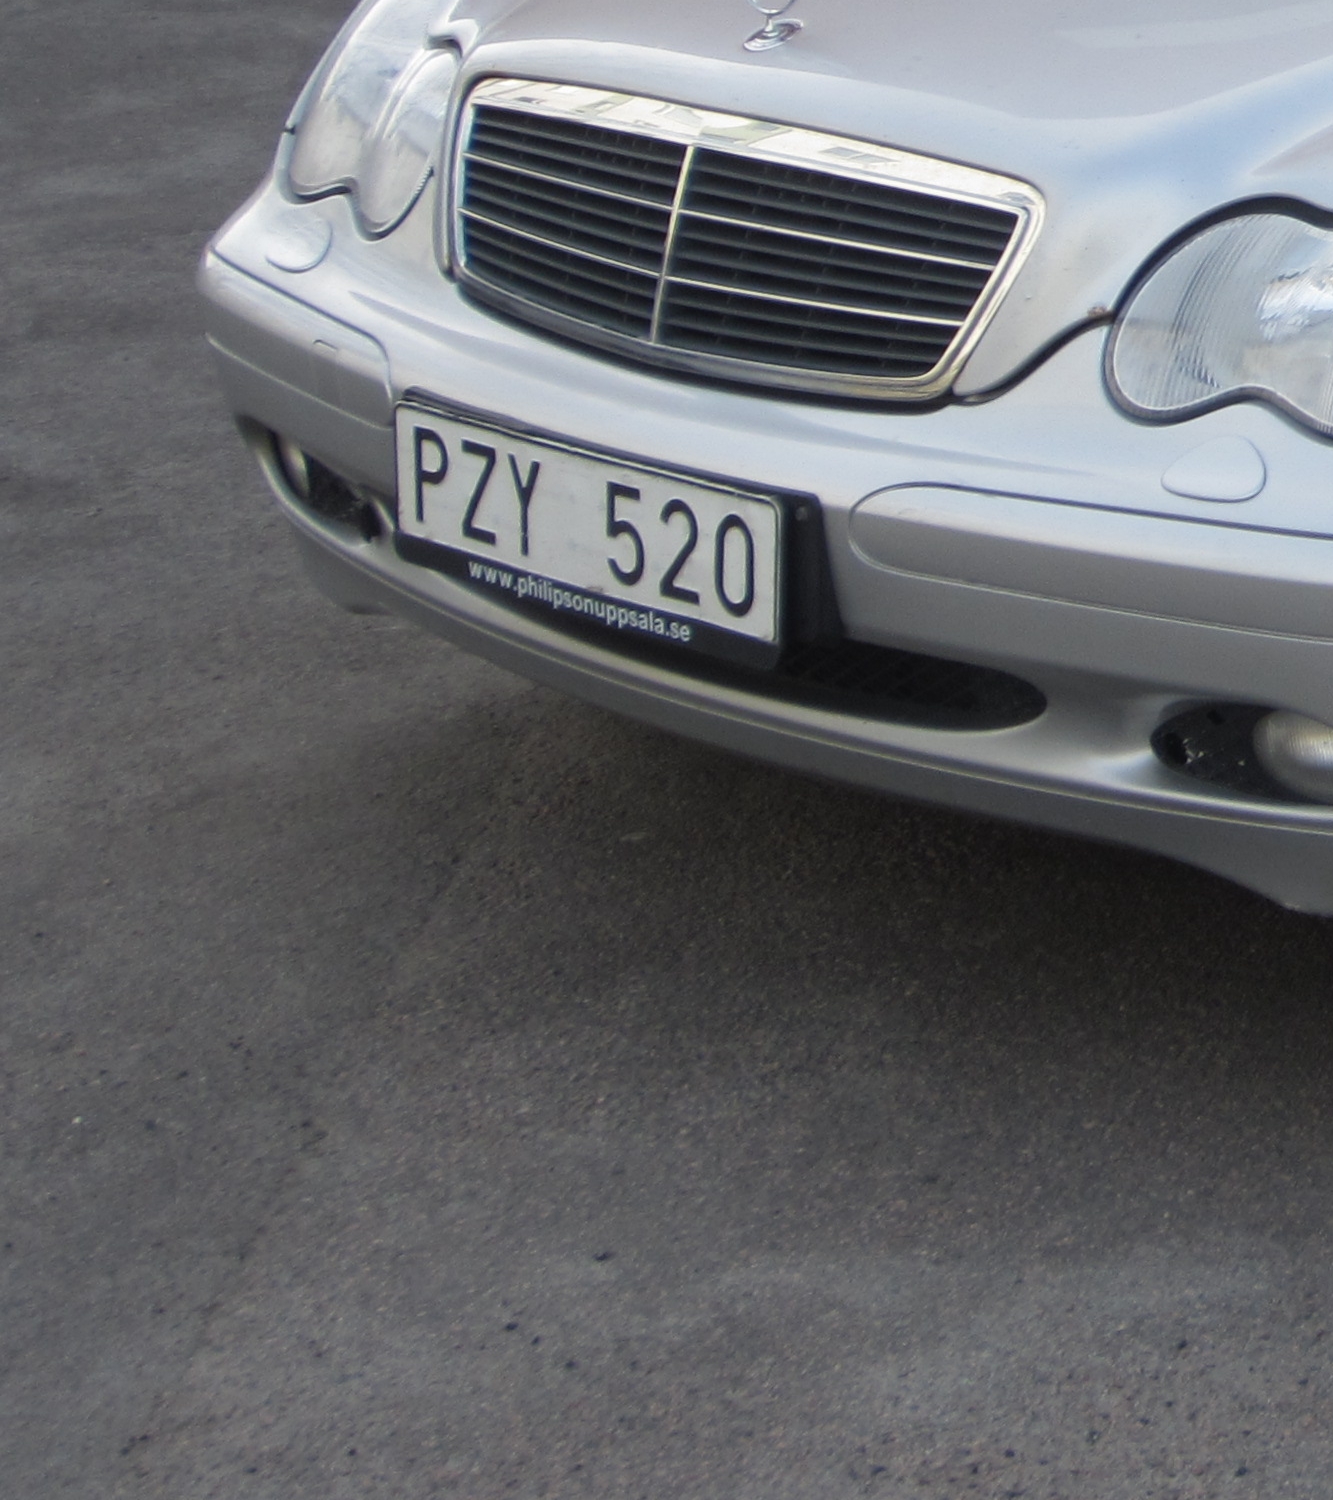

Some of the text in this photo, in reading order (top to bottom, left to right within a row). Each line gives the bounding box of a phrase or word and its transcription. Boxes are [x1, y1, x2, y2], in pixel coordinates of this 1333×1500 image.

[413, 425, 755, 618] PZY 520
[467, 558, 692, 643] www.philipsonuppsala.se
